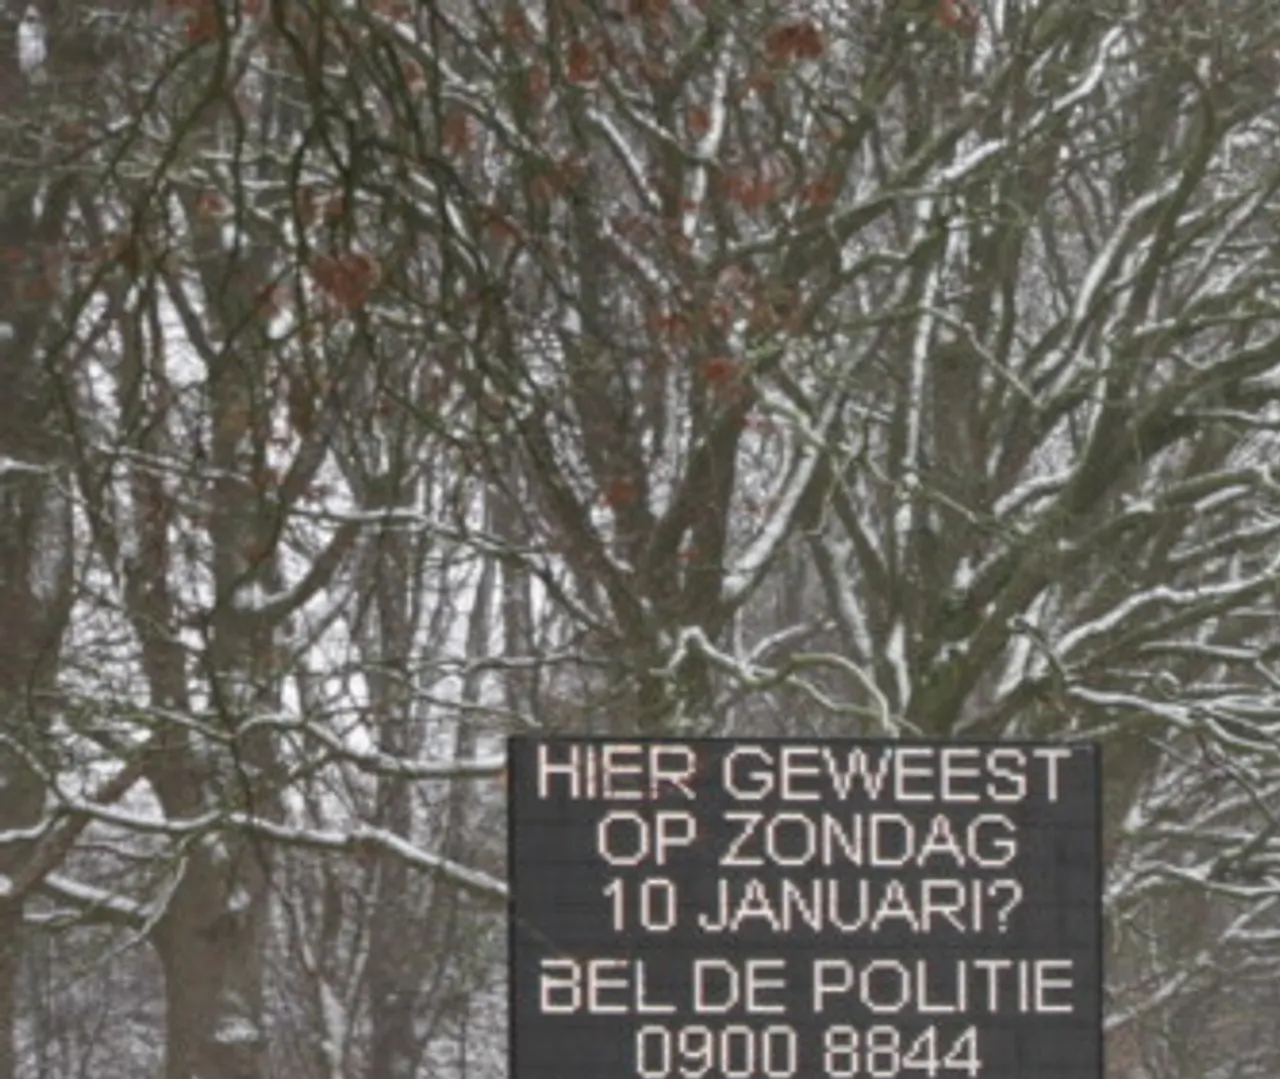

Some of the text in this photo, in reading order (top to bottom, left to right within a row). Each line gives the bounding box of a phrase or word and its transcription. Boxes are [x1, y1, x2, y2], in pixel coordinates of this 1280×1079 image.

[538, 744, 1072, 802] HIER GEWEEST
[597, 810, 1018, 867] OP ZONDAG
[603, 877, 1024, 932] 10 JANUARI?
[540, 958, 1073, 1014] BEL DE POLITIE
[636, 1024, 983, 1079] 0900 8844
